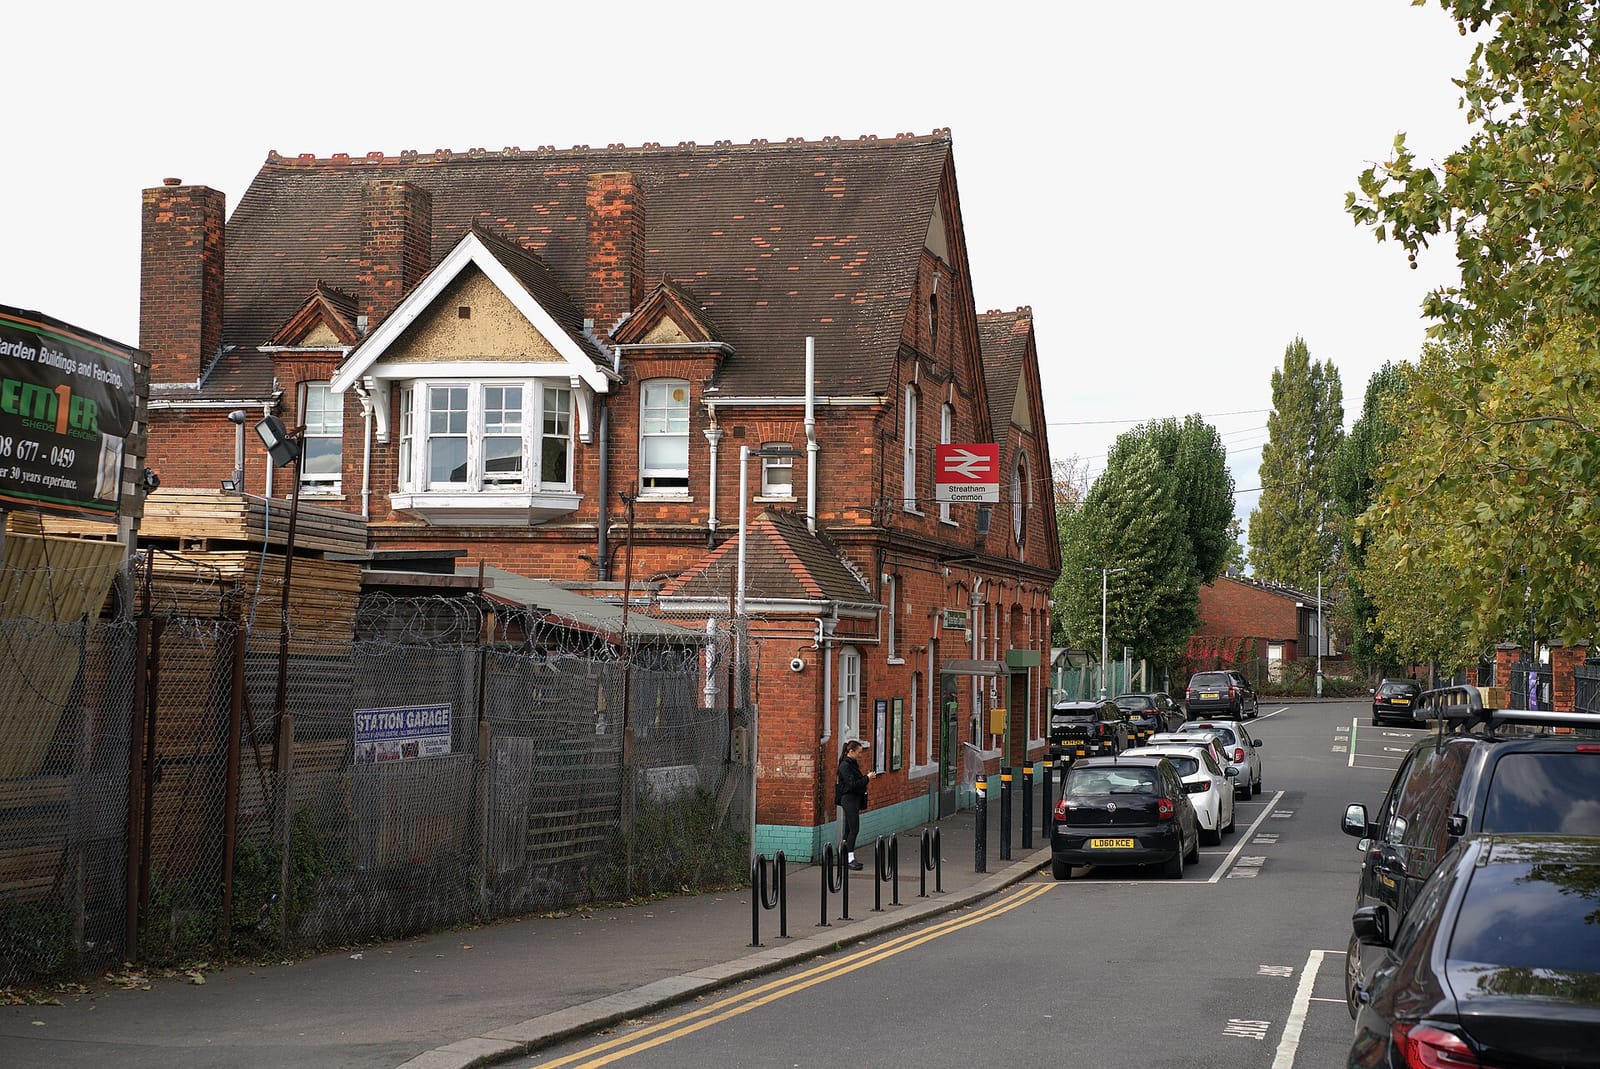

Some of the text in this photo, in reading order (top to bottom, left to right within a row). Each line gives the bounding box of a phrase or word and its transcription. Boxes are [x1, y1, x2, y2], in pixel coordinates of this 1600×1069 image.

[0, 337, 36, 361] arden
[38, 347, 77, 375] Buildings
[78, 362, 92, 378] and
[22, 418, 97, 442] SHEDS FENCING
[16, 440, 40, 462] 677
[50, 446, 75, 468] 0459
[9, 466, 20, 480] 30
[22, 471, 41, 484] years
[948, 485, 986, 493] Streatham
[357, 712, 404, 731] STATION
[406, 709, 449, 727] GARAGE
[1115, 839, 1131, 847] KCE
